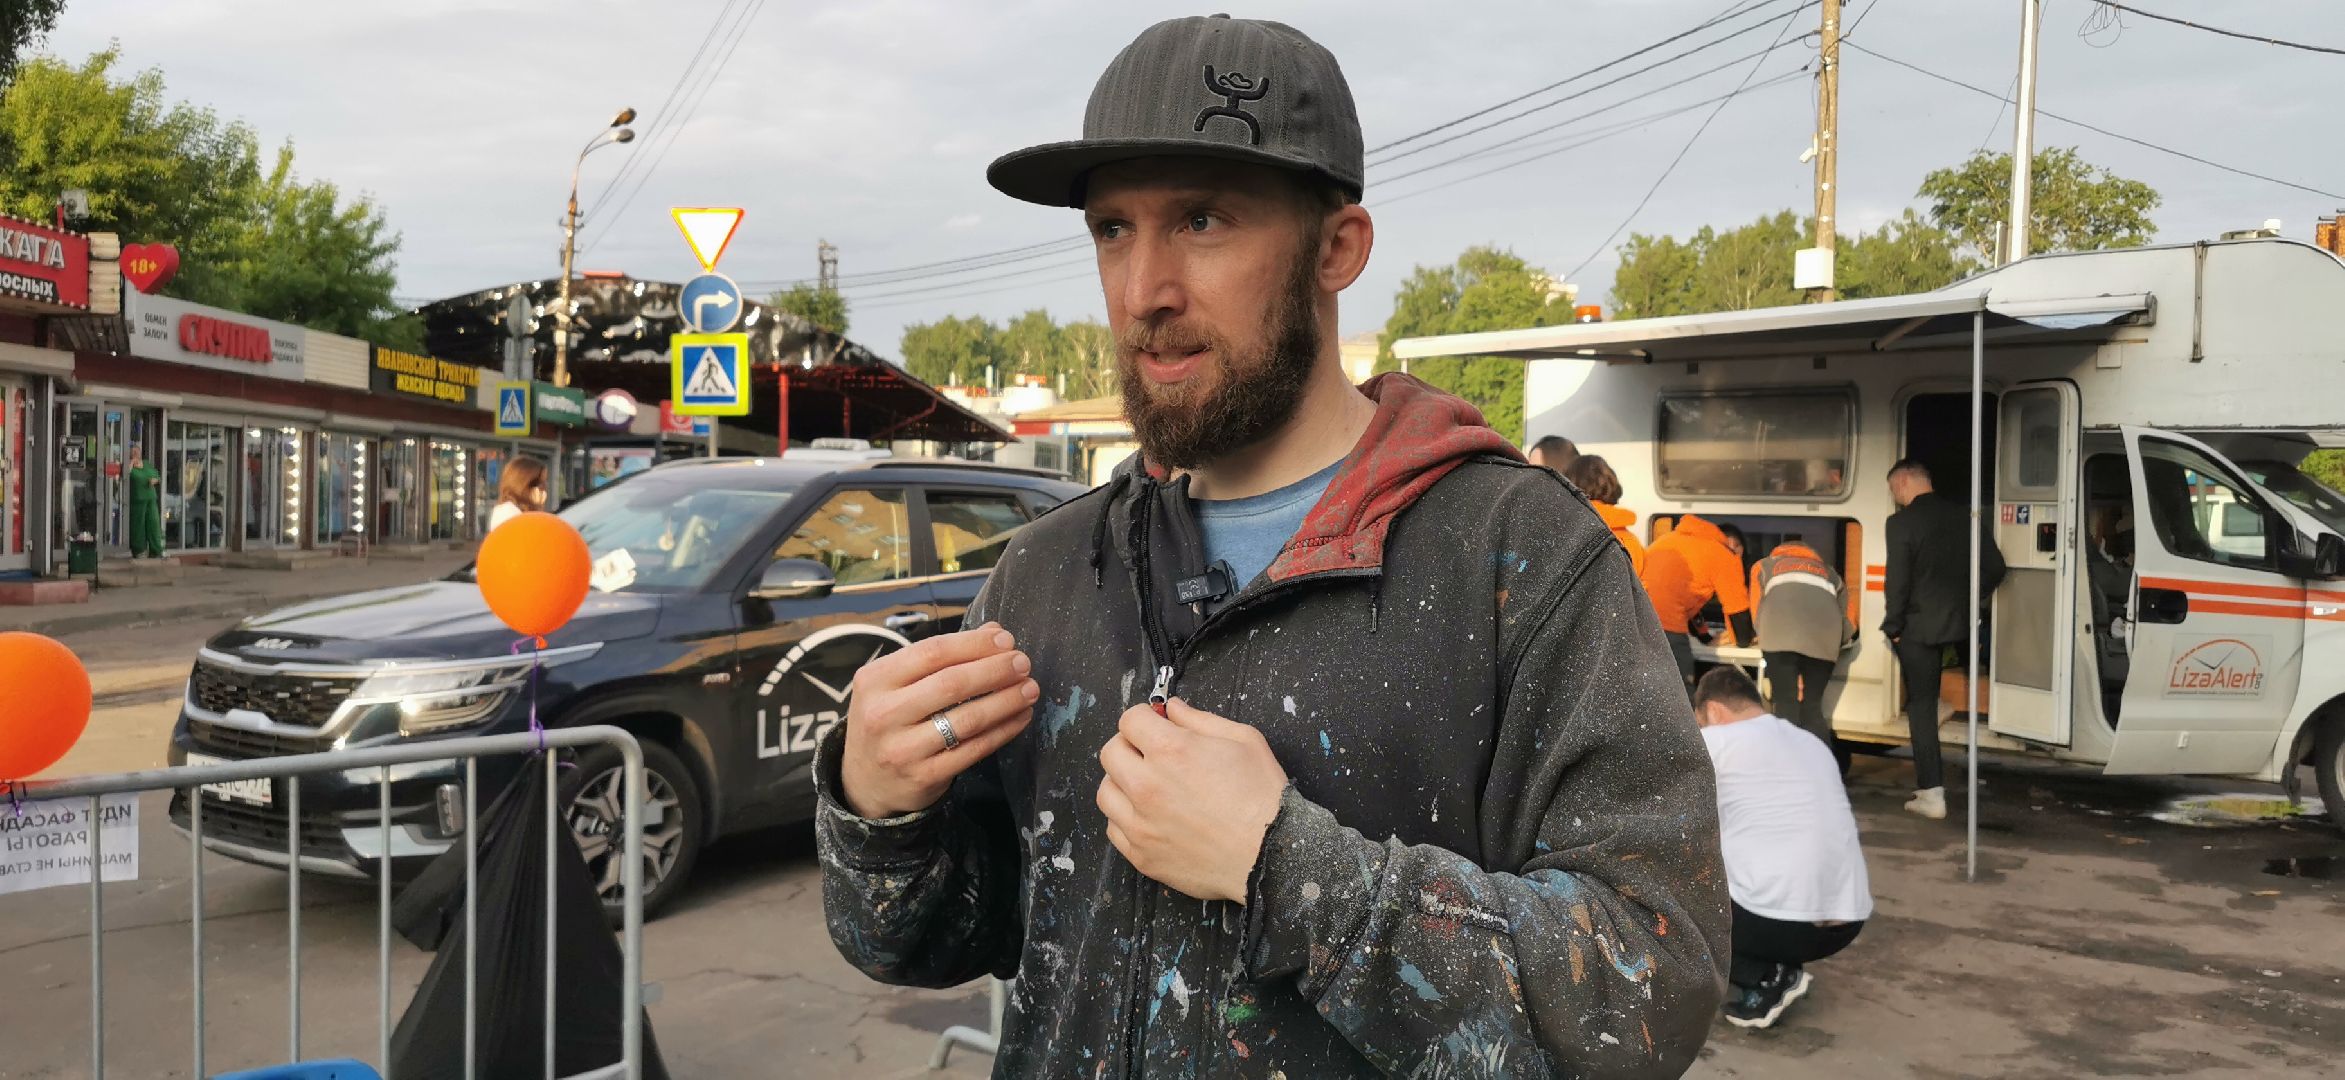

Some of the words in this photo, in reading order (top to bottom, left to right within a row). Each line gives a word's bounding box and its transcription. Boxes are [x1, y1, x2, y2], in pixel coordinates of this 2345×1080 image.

[130, 258, 158, 274] 18+
[0, 272, 54, 297] ослых
[179, 313, 273, 363] СКУПКА
[377, 347, 436, 378] ИВАНОВСКИЙ
[396, 373, 434, 397] ЖЕНСКАЯ
[435, 381, 465, 403] ОДЕЖДА
[2170, 666, 2257, 688] LizaAlert
